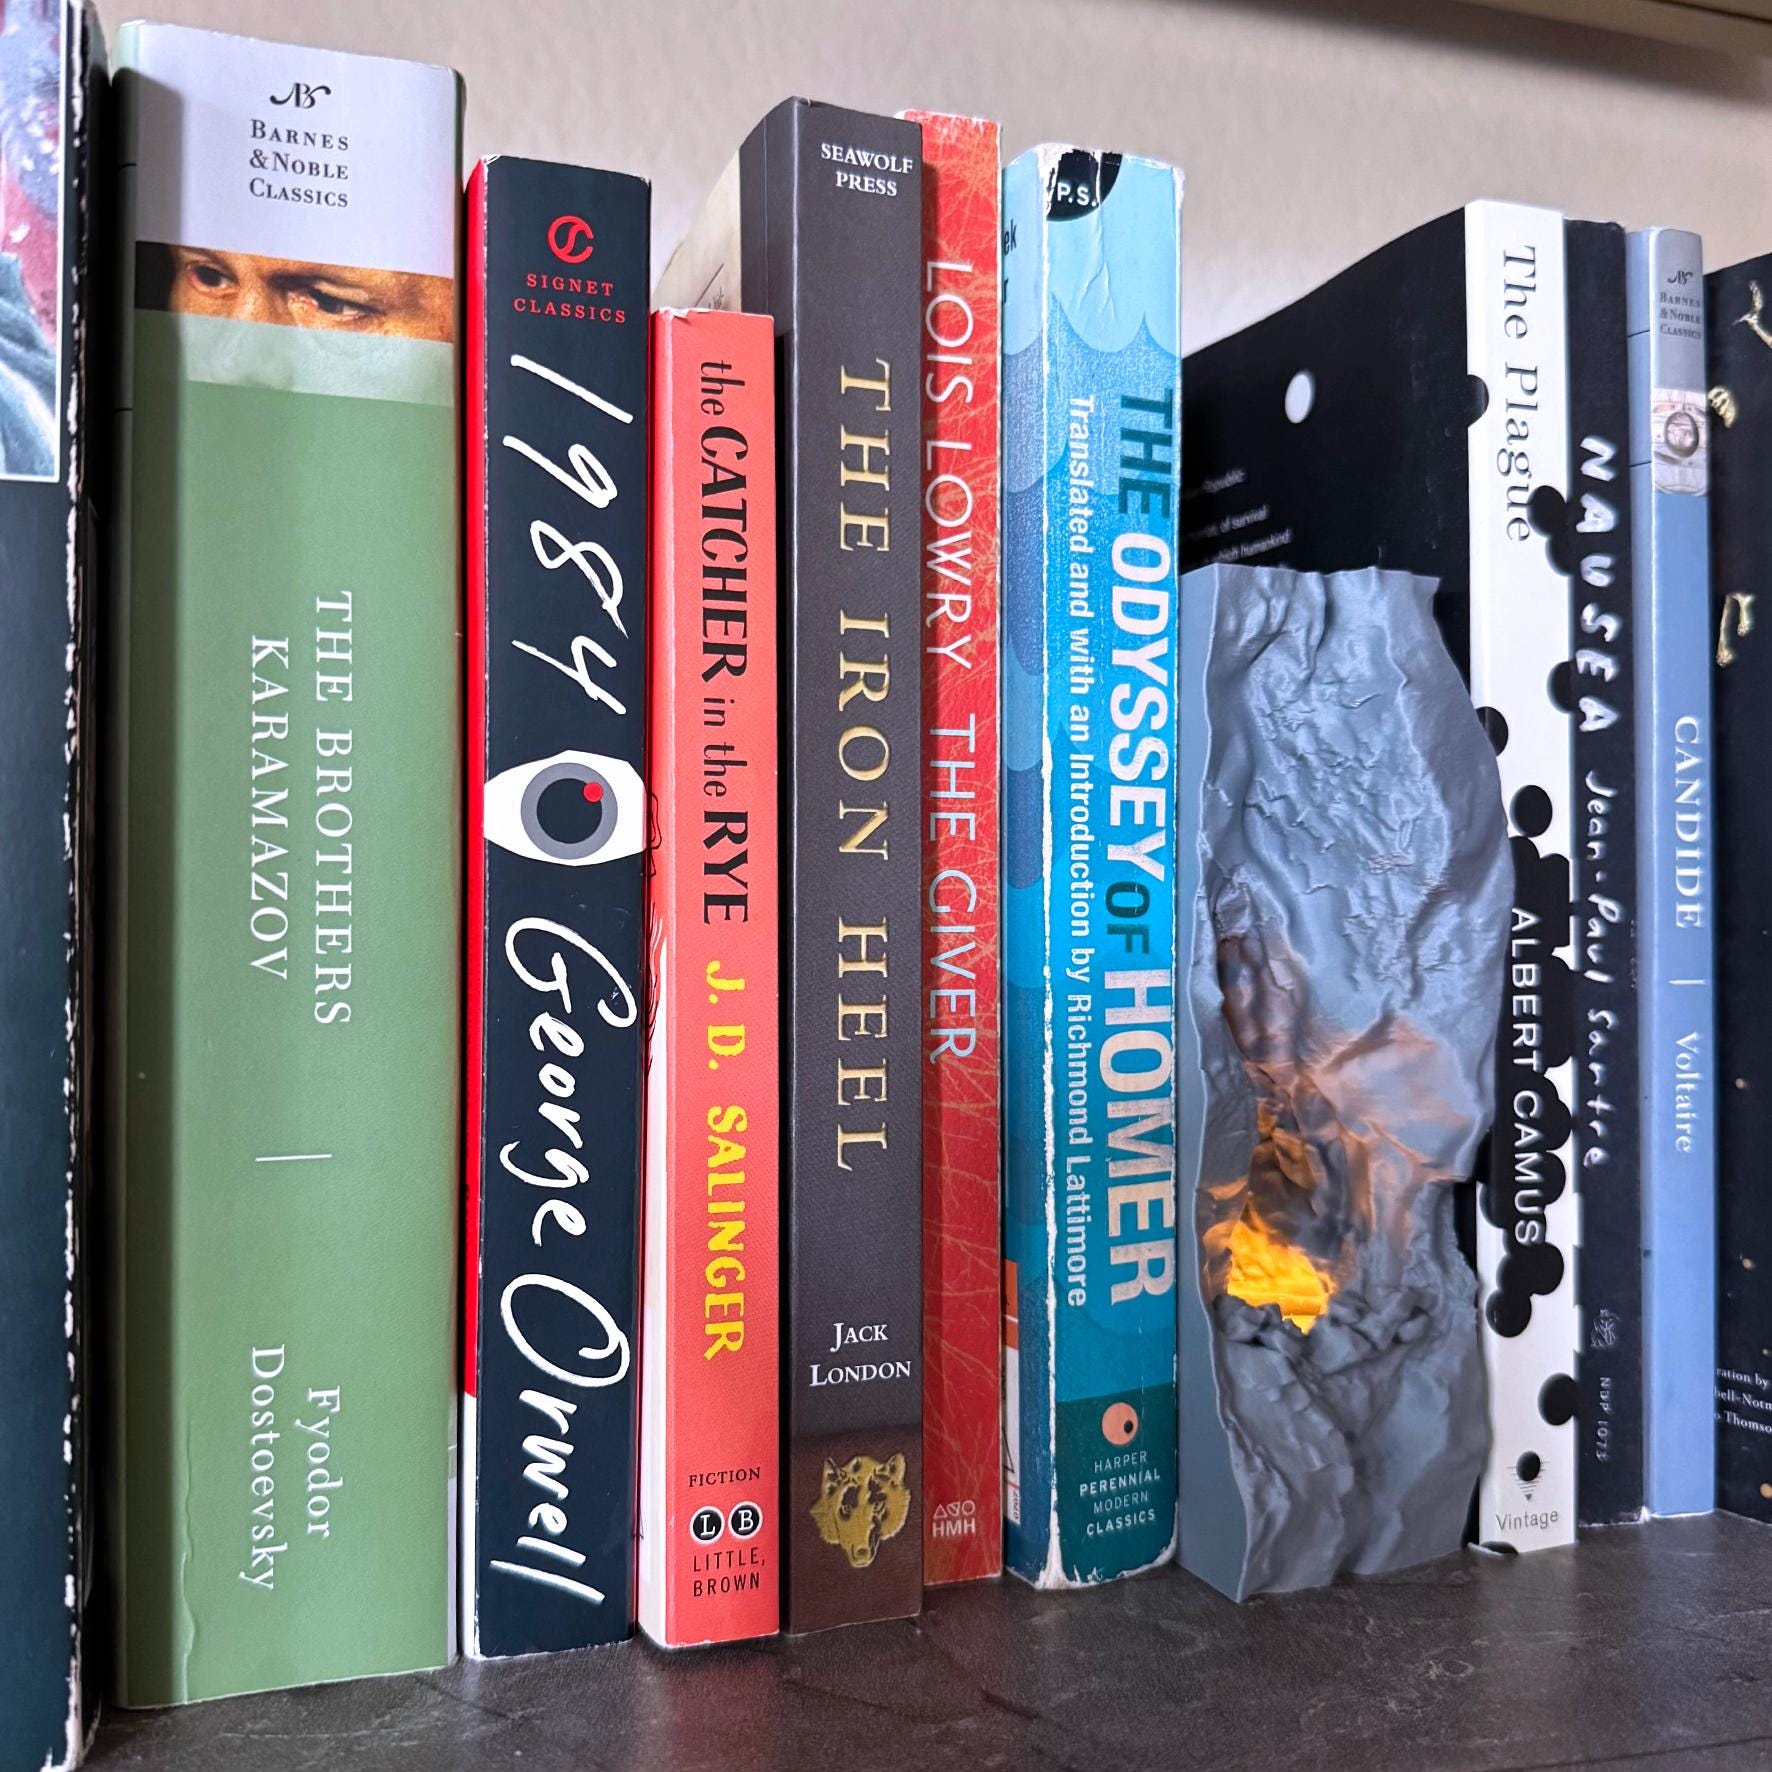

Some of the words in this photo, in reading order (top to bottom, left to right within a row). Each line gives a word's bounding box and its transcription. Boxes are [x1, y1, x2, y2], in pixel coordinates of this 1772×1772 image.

[250, 118, 349, 151] BARNES
[820, 142, 914, 175] SEAWOLF
[835, 170, 898, 198] PRESS
[249, 177, 349, 208] CLASSICS
[1057, 182, 1097, 207] P.S.
[513, 297, 626, 323] CLASSICS
[526, 273, 614, 297] SIGNET
[924, 261, 974, 404] LOIS
[1502, 245, 1537, 341] The
[699, 360, 746, 416] the
[839, 357, 892, 552] THE
[1069, 395, 1097, 552] Translated
[1118, 387, 1174, 520] THE
[1496, 360, 1538, 543] Plague
[502, 354, 634, 716] 1984
[700, 425, 749, 684] CATCHER
[924, 439, 973, 671] LOWRY
[1575, 434, 1622, 734] NAUSEA
[1069, 564, 1095, 618] and
[315, 590, 353, 702] THE
[1069, 627, 1096, 695] with
[702, 698, 736, 728] in
[837, 608, 890, 861] IRON
[1069, 706, 1090, 742] an
[1107, 532, 1172, 882] ODYSSEY
[249, 634, 290, 981] KARAMAZOV
[702, 741, 747, 798] the
[929, 713, 976, 842] THE
[703, 811, 749, 926] RYE
[1068, 754, 1095, 938] Introduction
[1674, 715, 1703, 930] CANDIDE
[313, 728, 353, 1025] BROTHERS
[1105, 880, 1151, 954] OF
[705, 961, 747, 1003] J.
[928, 869, 977, 1065] GIVER
[1066, 947, 1096, 984] by
[1511, 907, 1541, 1073] ALBERT
[500, 917, 637, 1247] George
[704, 1024, 746, 1071] D.
[836, 916, 889, 1172] HEEL
[1067, 993, 1094, 1148] Richmond
[1675, 1031, 1699, 1154] Voltaire
[1099, 968, 1175, 1306] HOMER
[1513, 1089, 1543, 1245] CAMUS
[702, 1104, 748, 1362] SALINGER
[1066, 1156, 1092, 1309] Lattimore
[809, 1360, 913, 1387] LONDON
[830, 1322, 888, 1353] JACK
[1716, 1368, 1752, 1384] ration
[1755, 1373, 1768, 1391] by
[239, 1343, 288, 1591] Dostoevsky
[294, 1385, 343, 1541] Fyodor
[490, 1272, 631, 1605] Orwell
[1094, 1450, 1148, 1474] HARPER
[1724, 1410, 1772, 1435] Thomso
[688, 1466, 761, 1488] FICTION
[932, 1517, 977, 1537] HMH
[1079, 1467, 1161, 1498] PERENNIAL
[1086, 1508, 1156, 1537] CLASSICS
[1093, 1490, 1149, 1514] MODERN
[1495, 1508, 1560, 1532] Vintage
[693, 1547, 766, 1573] LITTLE,
[693, 1572, 760, 1597] BROWN
